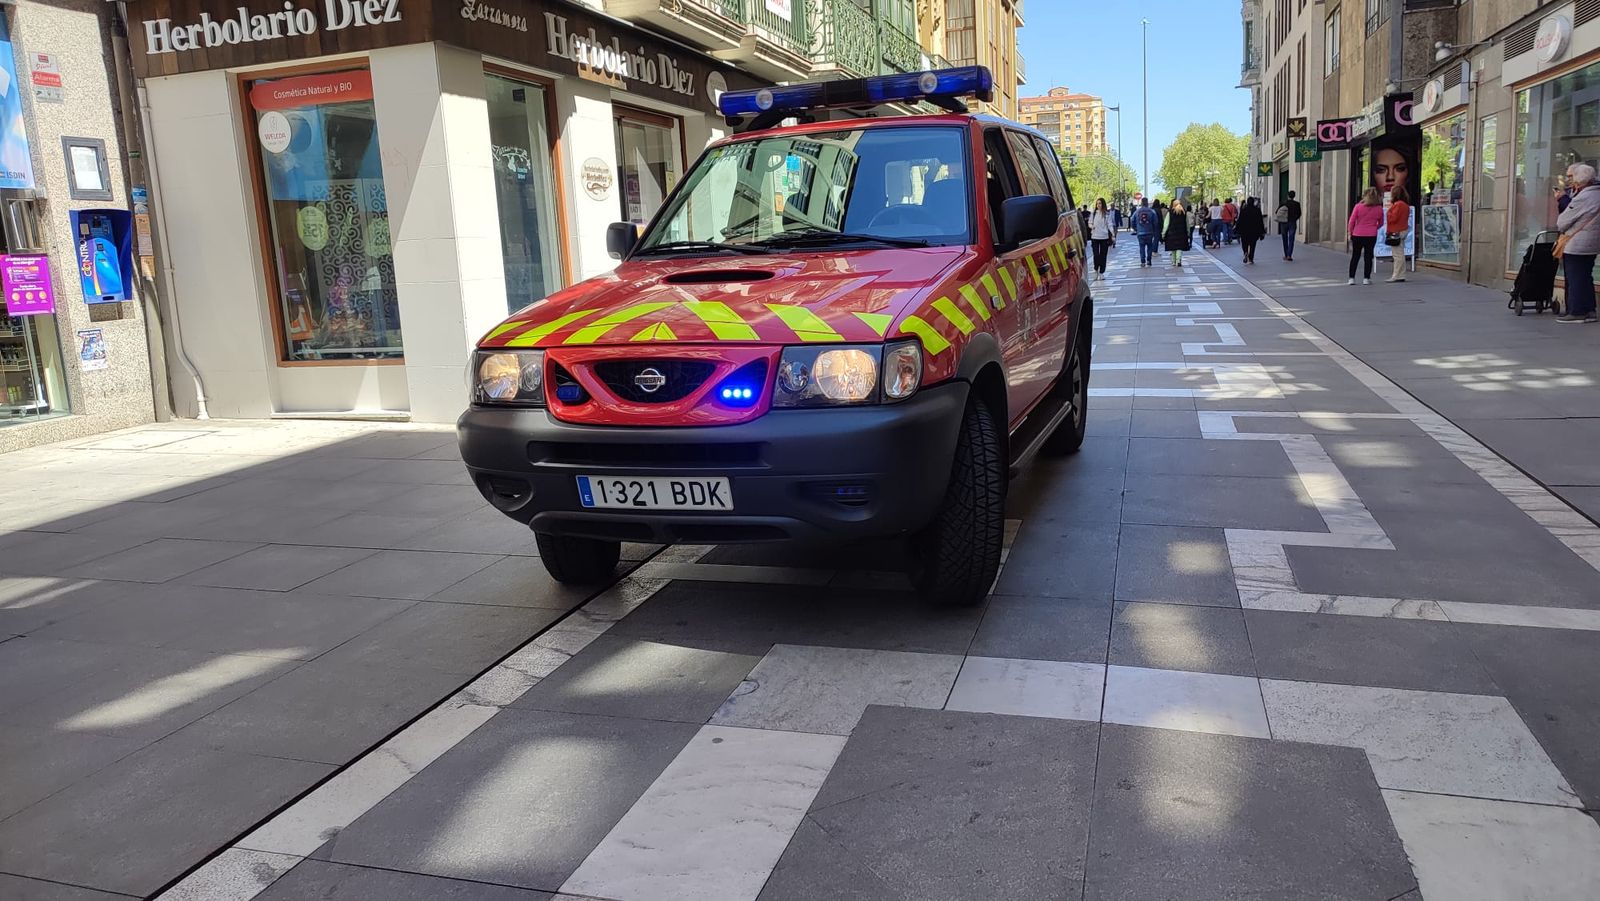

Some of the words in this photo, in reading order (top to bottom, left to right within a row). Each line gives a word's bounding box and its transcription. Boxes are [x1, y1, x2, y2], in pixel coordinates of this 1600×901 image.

[142, 1, 317, 55] Herbolario
[461, 0, 528, 32] Zarzamora
[543, 12, 658, 85] Herbolario
[273, 87, 307, 99] Cosmética
[308, 83, 333, 95] Natural
[333, 85, 339, 94] y
[339, 81, 352, 92] BIO
[6, 171, 26, 179] ISDIN
[584, 494, 591, 502] E
[597, 480, 659, 507] 1321
[670, 481, 726, 508] BDK
